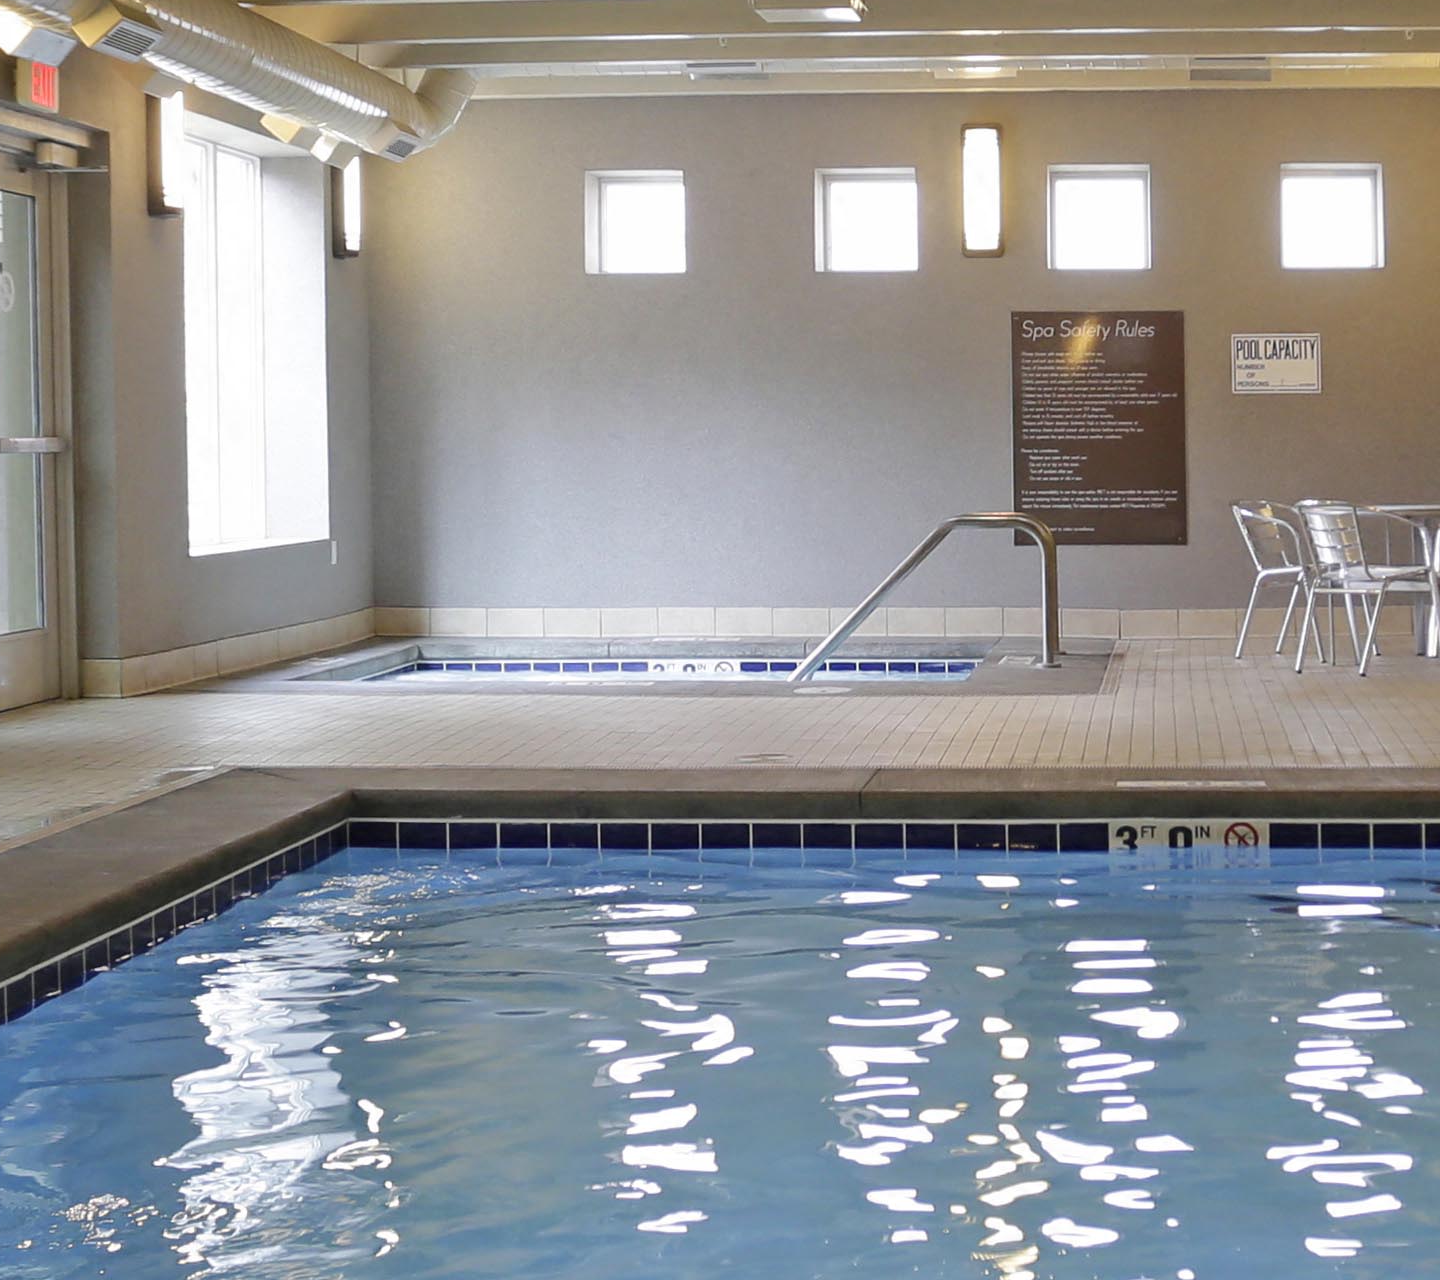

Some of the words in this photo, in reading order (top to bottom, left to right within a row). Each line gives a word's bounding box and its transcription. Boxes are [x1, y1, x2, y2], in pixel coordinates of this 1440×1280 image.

[1022, 320, 1055, 341] Spa
[1060, 320, 1111, 341] Safety
[1115, 320, 1156, 337] Rules
[1236, 340, 1263, 360] POOL
[1264, 339, 1318, 360] CAPACITY
[1116, 826, 1138, 851] 3
[1141, 826, 1157, 838] FT
[1195, 826, 1210, 838] IN
